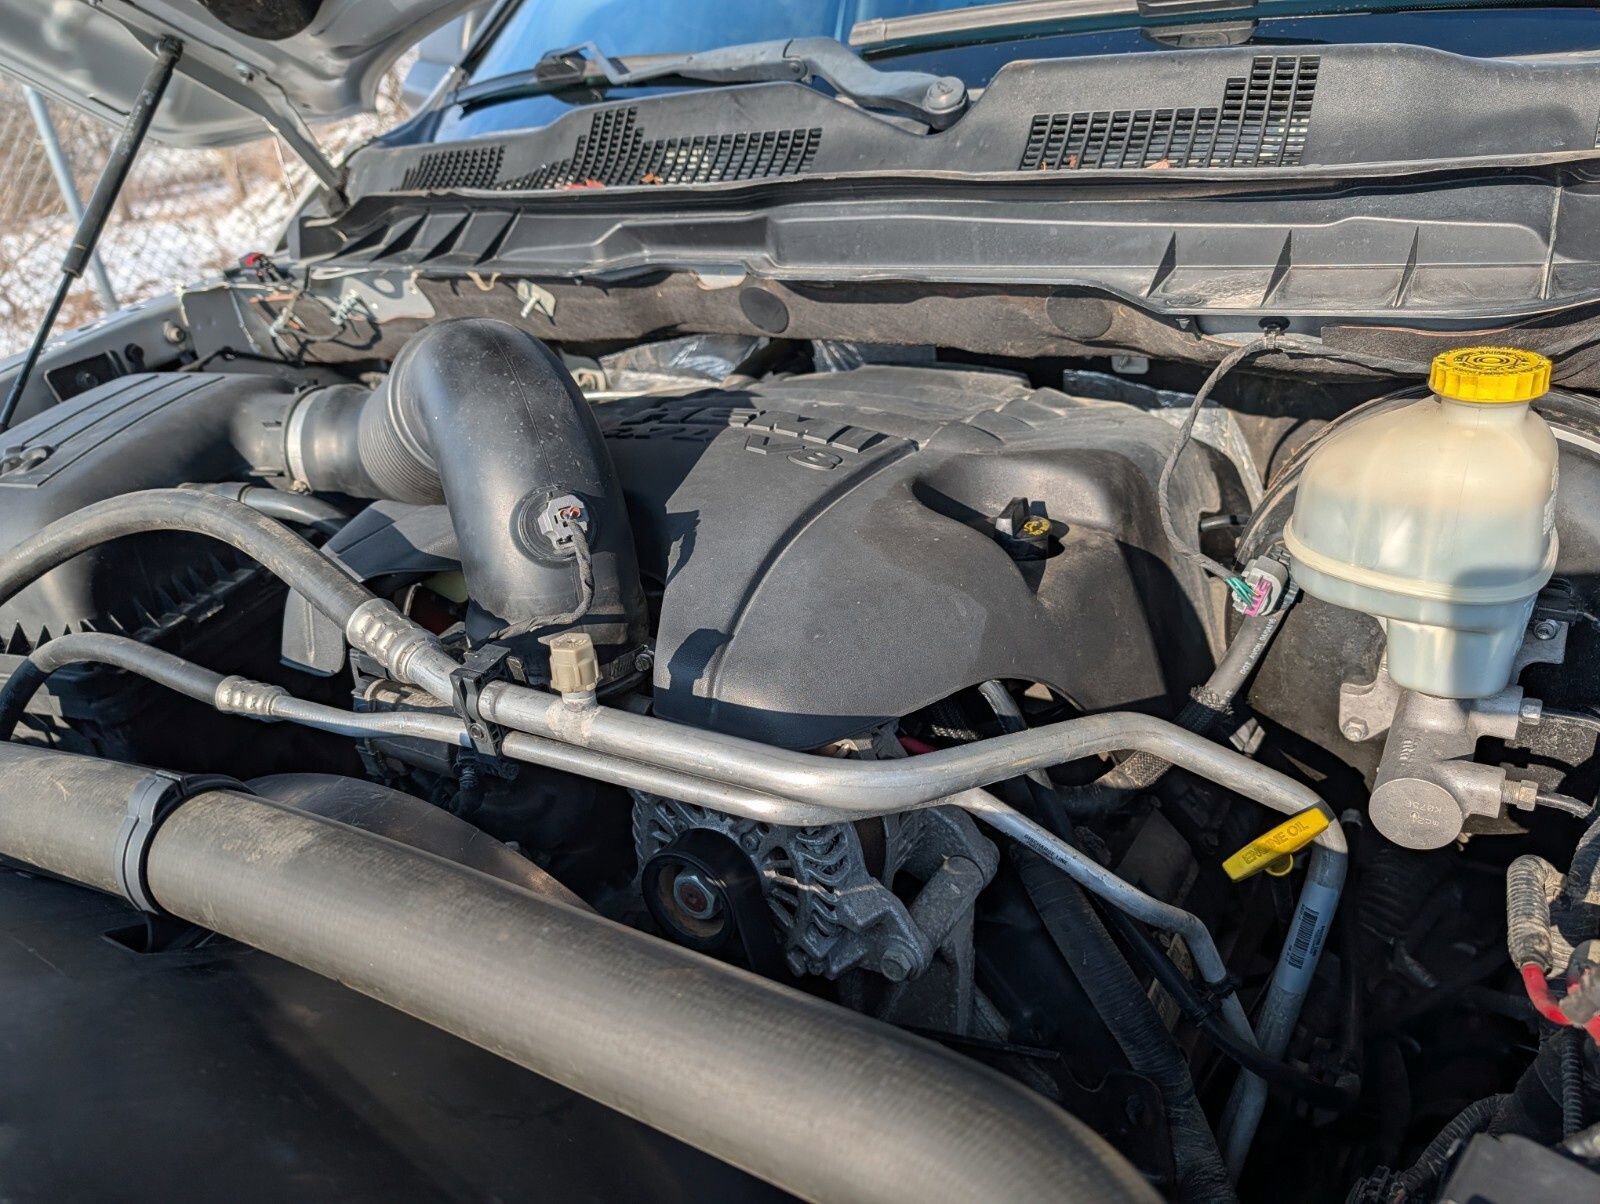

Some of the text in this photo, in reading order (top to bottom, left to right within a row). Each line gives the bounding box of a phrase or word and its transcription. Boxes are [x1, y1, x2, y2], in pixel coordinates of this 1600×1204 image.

[619, 406, 886, 454] HEMI
[744, 432, 843, 471] V8
[1287, 821, 1310, 837] OIL
[1055, 855, 1068, 865] LINE
